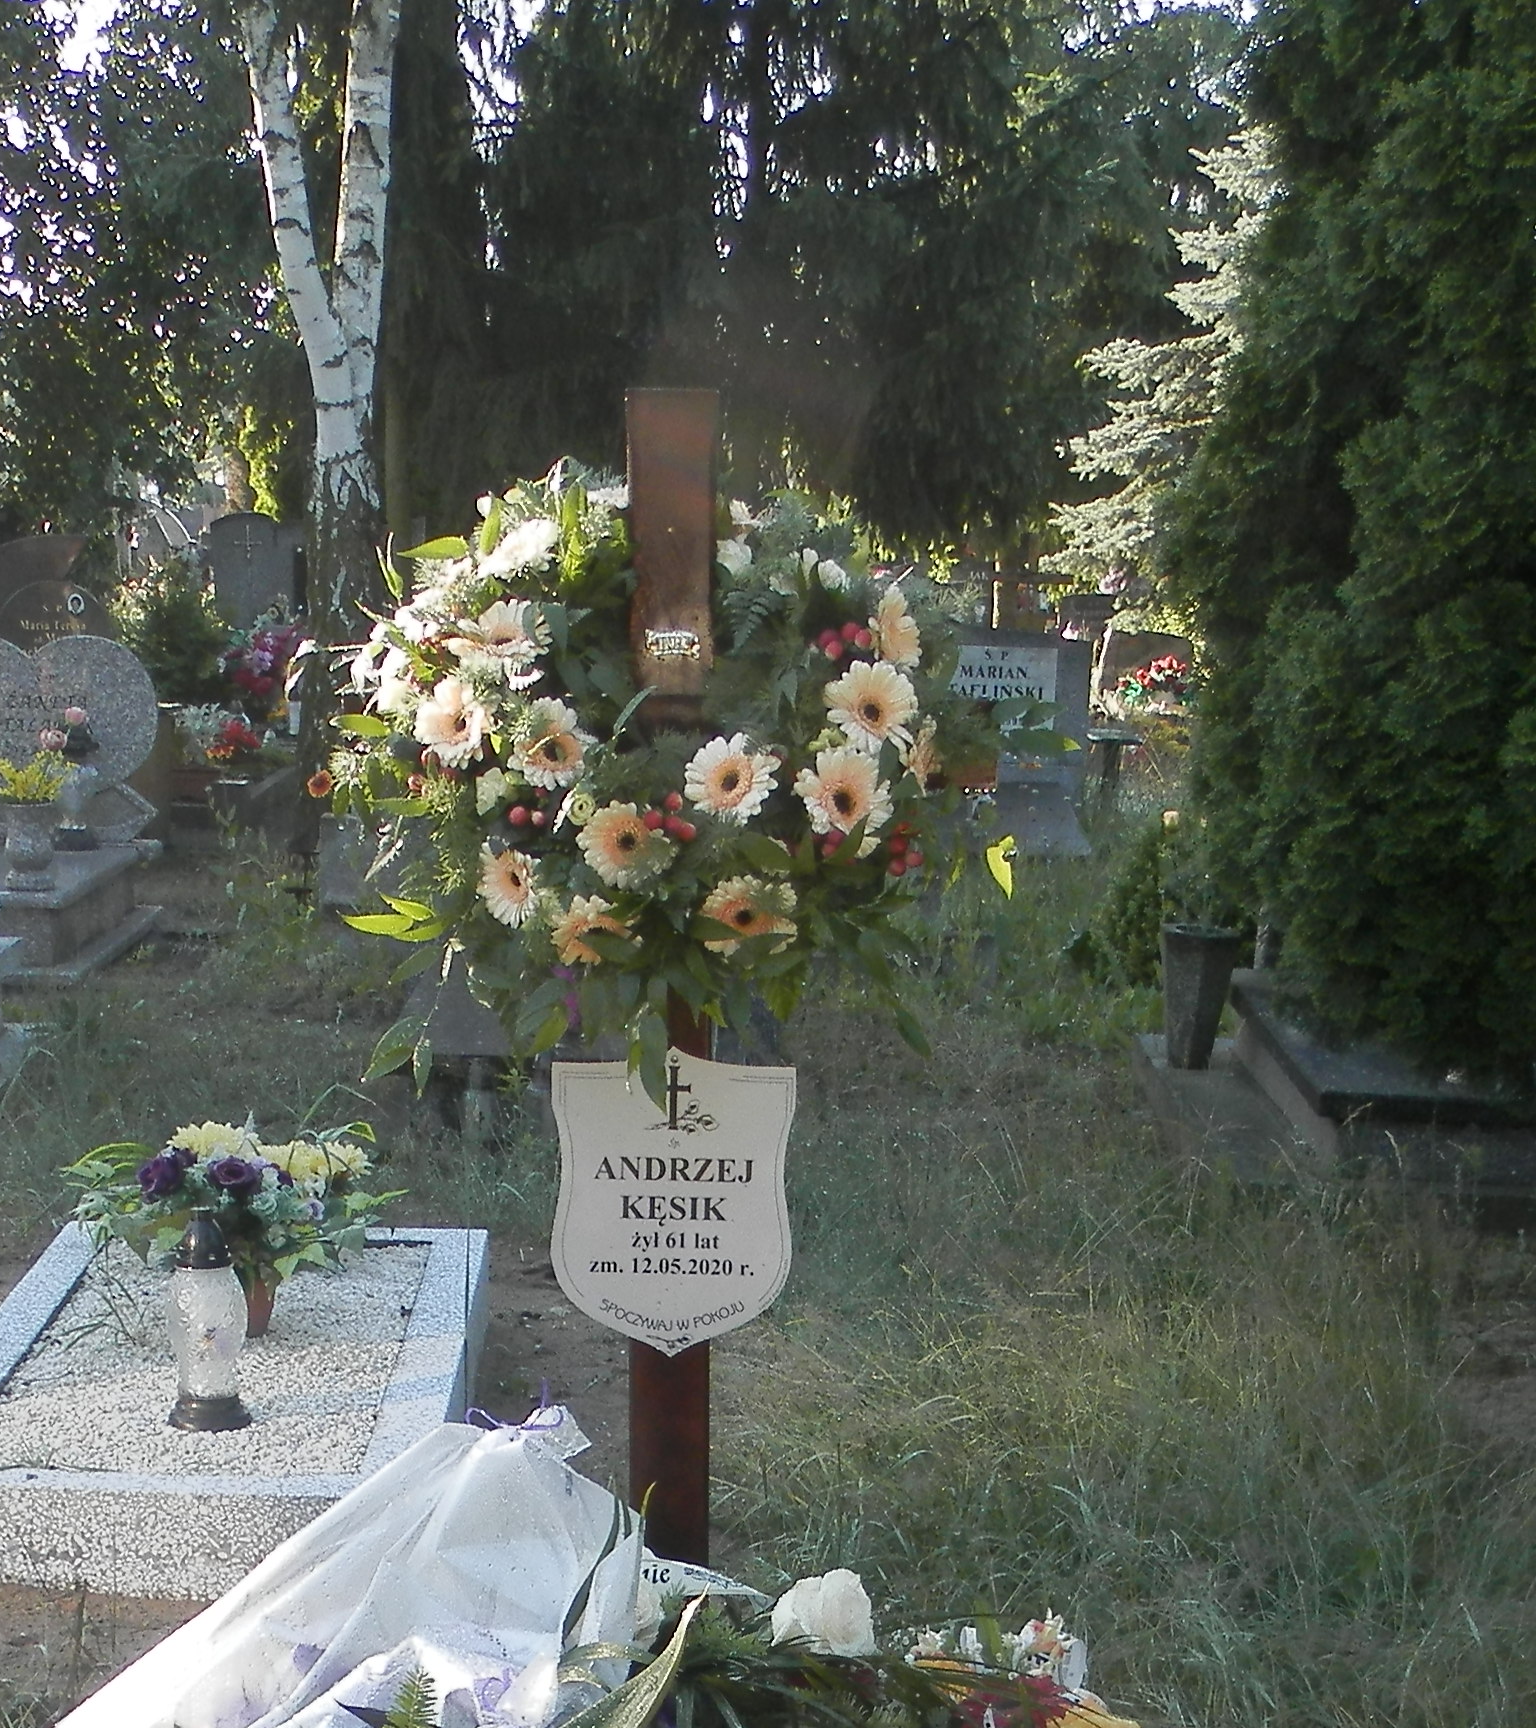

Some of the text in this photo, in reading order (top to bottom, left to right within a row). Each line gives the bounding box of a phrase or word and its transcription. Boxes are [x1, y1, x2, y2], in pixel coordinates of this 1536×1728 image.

[959, 664, 1030, 680] MARIAN
[593, 1156, 754, 1184] ANDRZEJ
[619, 1194, 728, 1227] KĘSIK
[631, 1231, 721, 1252] żył 61 lat
[589, 1256, 755, 1277] zm. 12.05.2020 r.
[599, 1298, 746, 1332] SPOCZYWAJ W POKOJU
